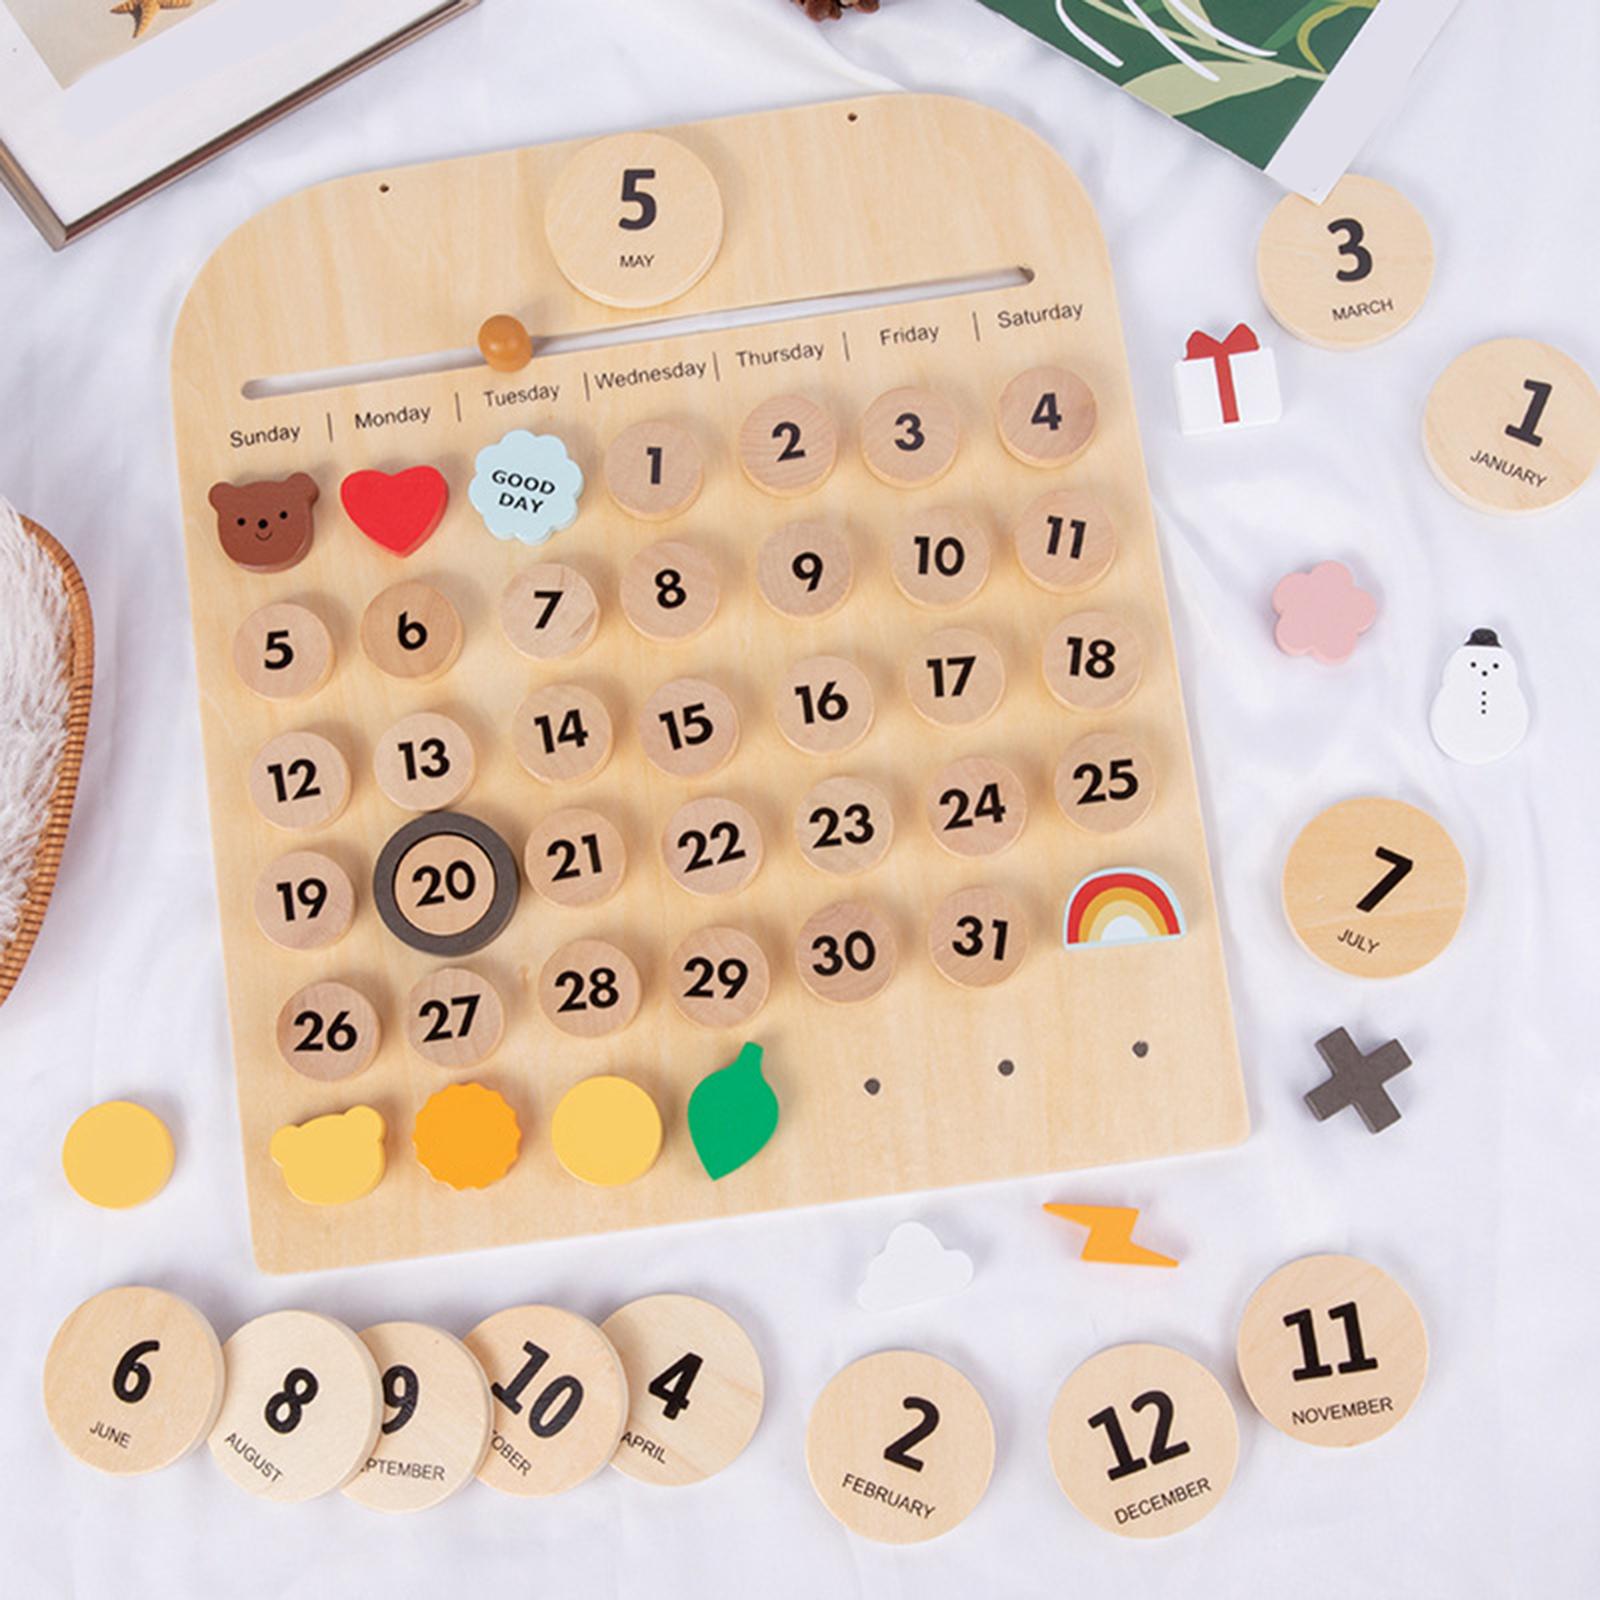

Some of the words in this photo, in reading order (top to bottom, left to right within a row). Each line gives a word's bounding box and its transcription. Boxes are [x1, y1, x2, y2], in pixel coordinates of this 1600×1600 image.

[618, 168, 657, 231] 5
[620, 255, 655, 268] MAY
[1327, 218, 1373, 282] 3
[1332, 299, 1394, 320] MARCH
[230, 426, 301, 448] Sunday
[354, 407, 430, 429] Monday
[483, 385, 558, 407] Tuesday
[594, 362, 706, 390] Wednesday
[735, 343, 824, 367] Thursday
[878, 326, 940, 350] Friday
[997, 304, 1083, 329] Saturday
[894, 412, 925, 452] 3
[1030, 392, 1063, 431] 4
[1504, 379, 1553, 448] 1
[771, 421, 806, 462] 2
[491, 469, 556, 496] GOOD
[646, 446, 663, 485] 1
[1470, 448, 1547, 487] JANUARY
[498, 490, 546, 513] DAY
[914, 535, 965, 577] 10
[1047, 515, 1087, 560] 11
[654, 568, 687, 610] 8
[791, 551, 824, 592] 9
[397, 611, 428, 651] 6
[533, 590, 564, 630] 7
[264, 629, 294, 671] 5
[1066, 636, 1116, 680] 18
[926, 655, 977, 698] 17
[794, 681, 849, 725] 16
[533, 708, 589, 755] 14
[658, 702, 714, 751] 15
[266, 758, 321, 803] 12
[397, 737, 451, 781] 13
[1072, 758, 1139, 806] 25
[809, 803, 875, 849] 23
[939, 782, 1007, 831] 24
[546, 833, 603, 882] 21
[677, 821, 747, 875] 22
[276, 877, 328, 922] 19
[412, 859, 476, 908] 20
[1355, 846, 1414, 913] 7
[811, 930, 876, 977] 30
[951, 915, 1009, 961] 31
[1336, 927, 1381, 955] JULY
[554, 967, 620, 1013] 28
[683, 956, 749, 1000] 29
[293, 1010, 358, 1052] 26
[418, 994, 481, 1043] 27
[1282, 1301, 1379, 1382] 11
[112, 1339, 161, 1404] 6
[489, 1340, 584, 1440] 10
[647, 1352, 704, 1421] 4
[264, 1367, 319, 1435] 8
[380, 1364, 419, 1436] 9
[1292, 1397, 1393, 1424] NOVEMBER
[88, 1421, 131, 1449] JUNE
[225, 1432, 284, 1482] AUGUST
[490, 1429, 533, 1477] OBER
[619, 1430, 667, 1465] APRIL
[883, 1396, 940, 1473] 2
[1087, 1390, 1192, 1482] 12
[359, 1456, 446, 1481] PTEMBER
[842, 1473, 935, 1519] FEBRUARY
[1113, 1477, 1211, 1525] DECEMBER
